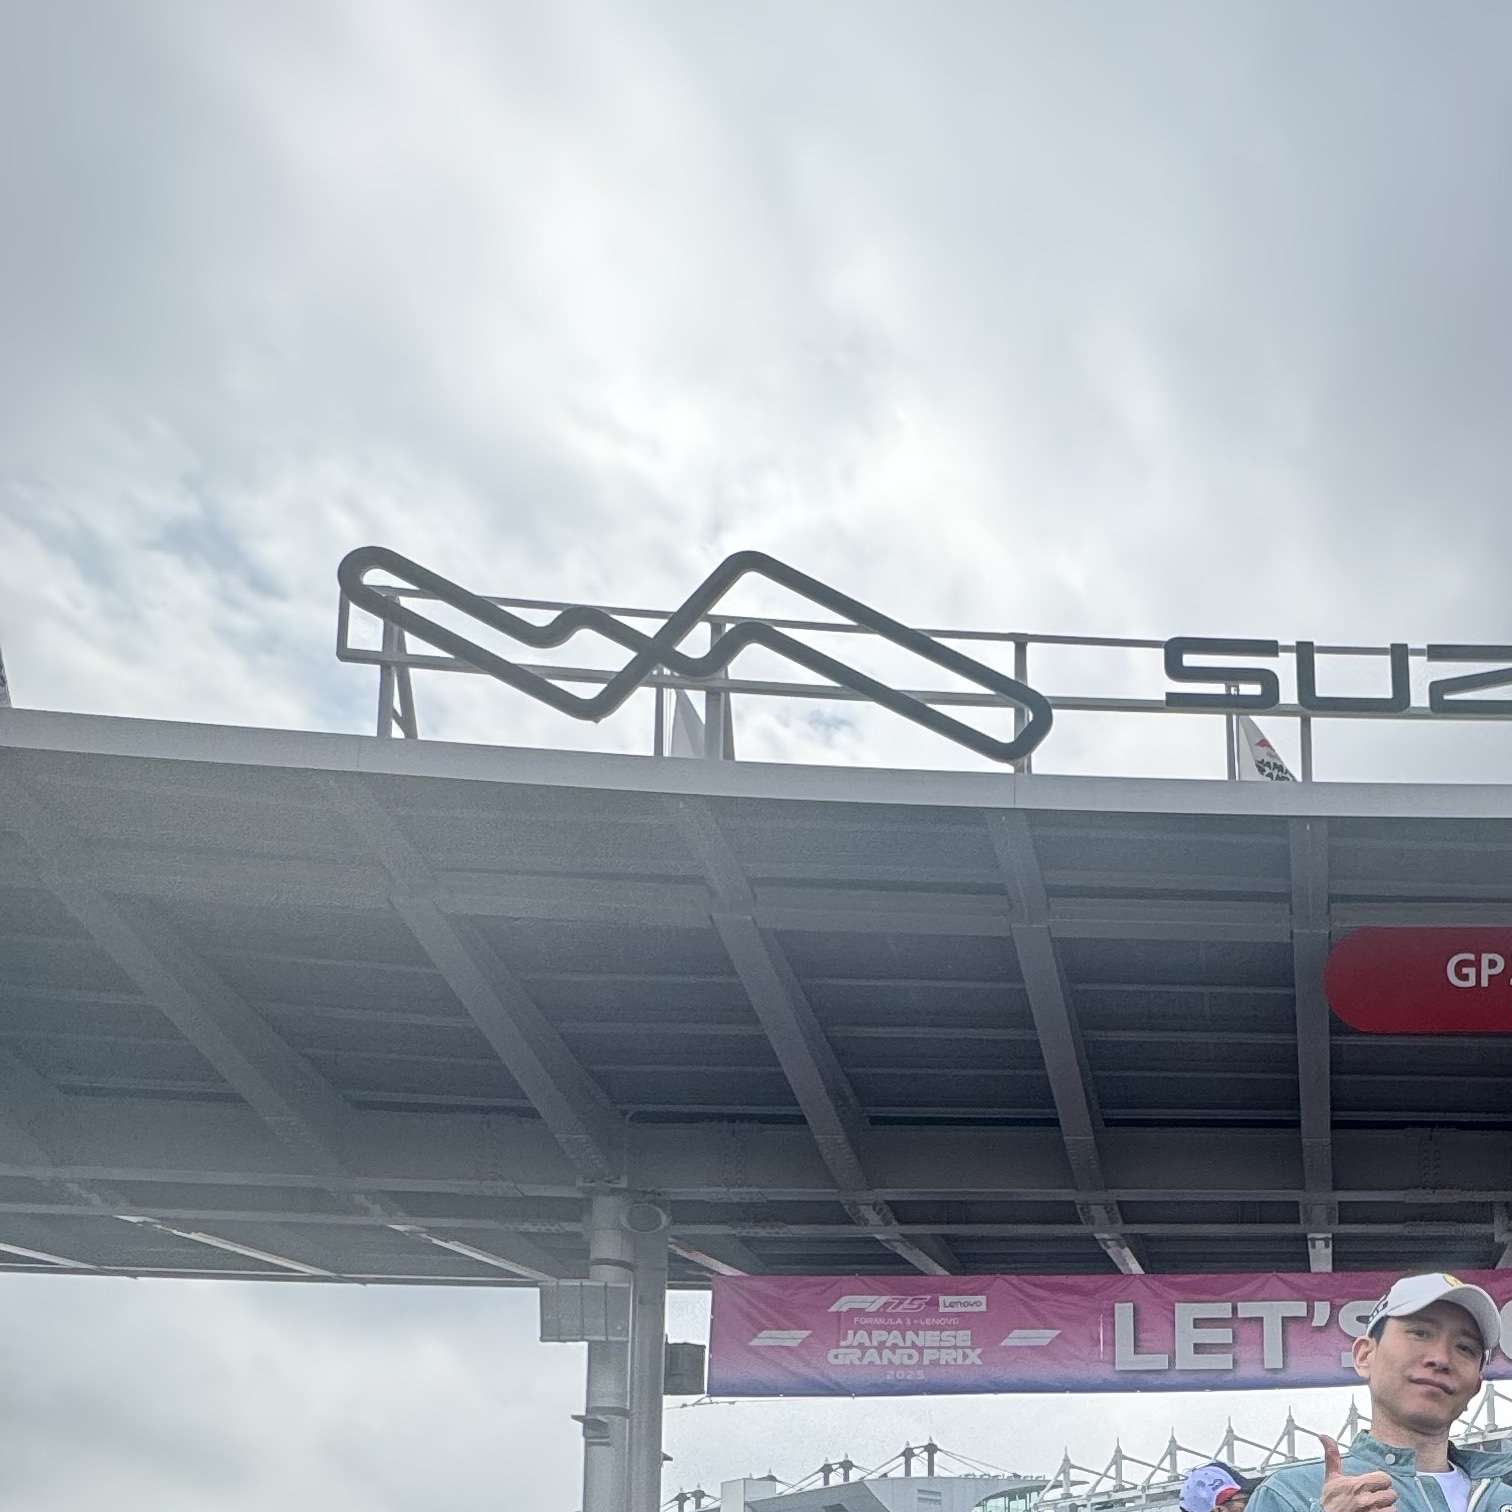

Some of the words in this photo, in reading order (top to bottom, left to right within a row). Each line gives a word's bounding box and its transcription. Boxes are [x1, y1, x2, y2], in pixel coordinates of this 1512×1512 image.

[840, 1330, 972, 1346] JAPANESE
[827, 1348, 920, 1365] GRAND
[923, 1348, 984, 1365] PRIX
[886, 1370, 926, 1380] 2025
